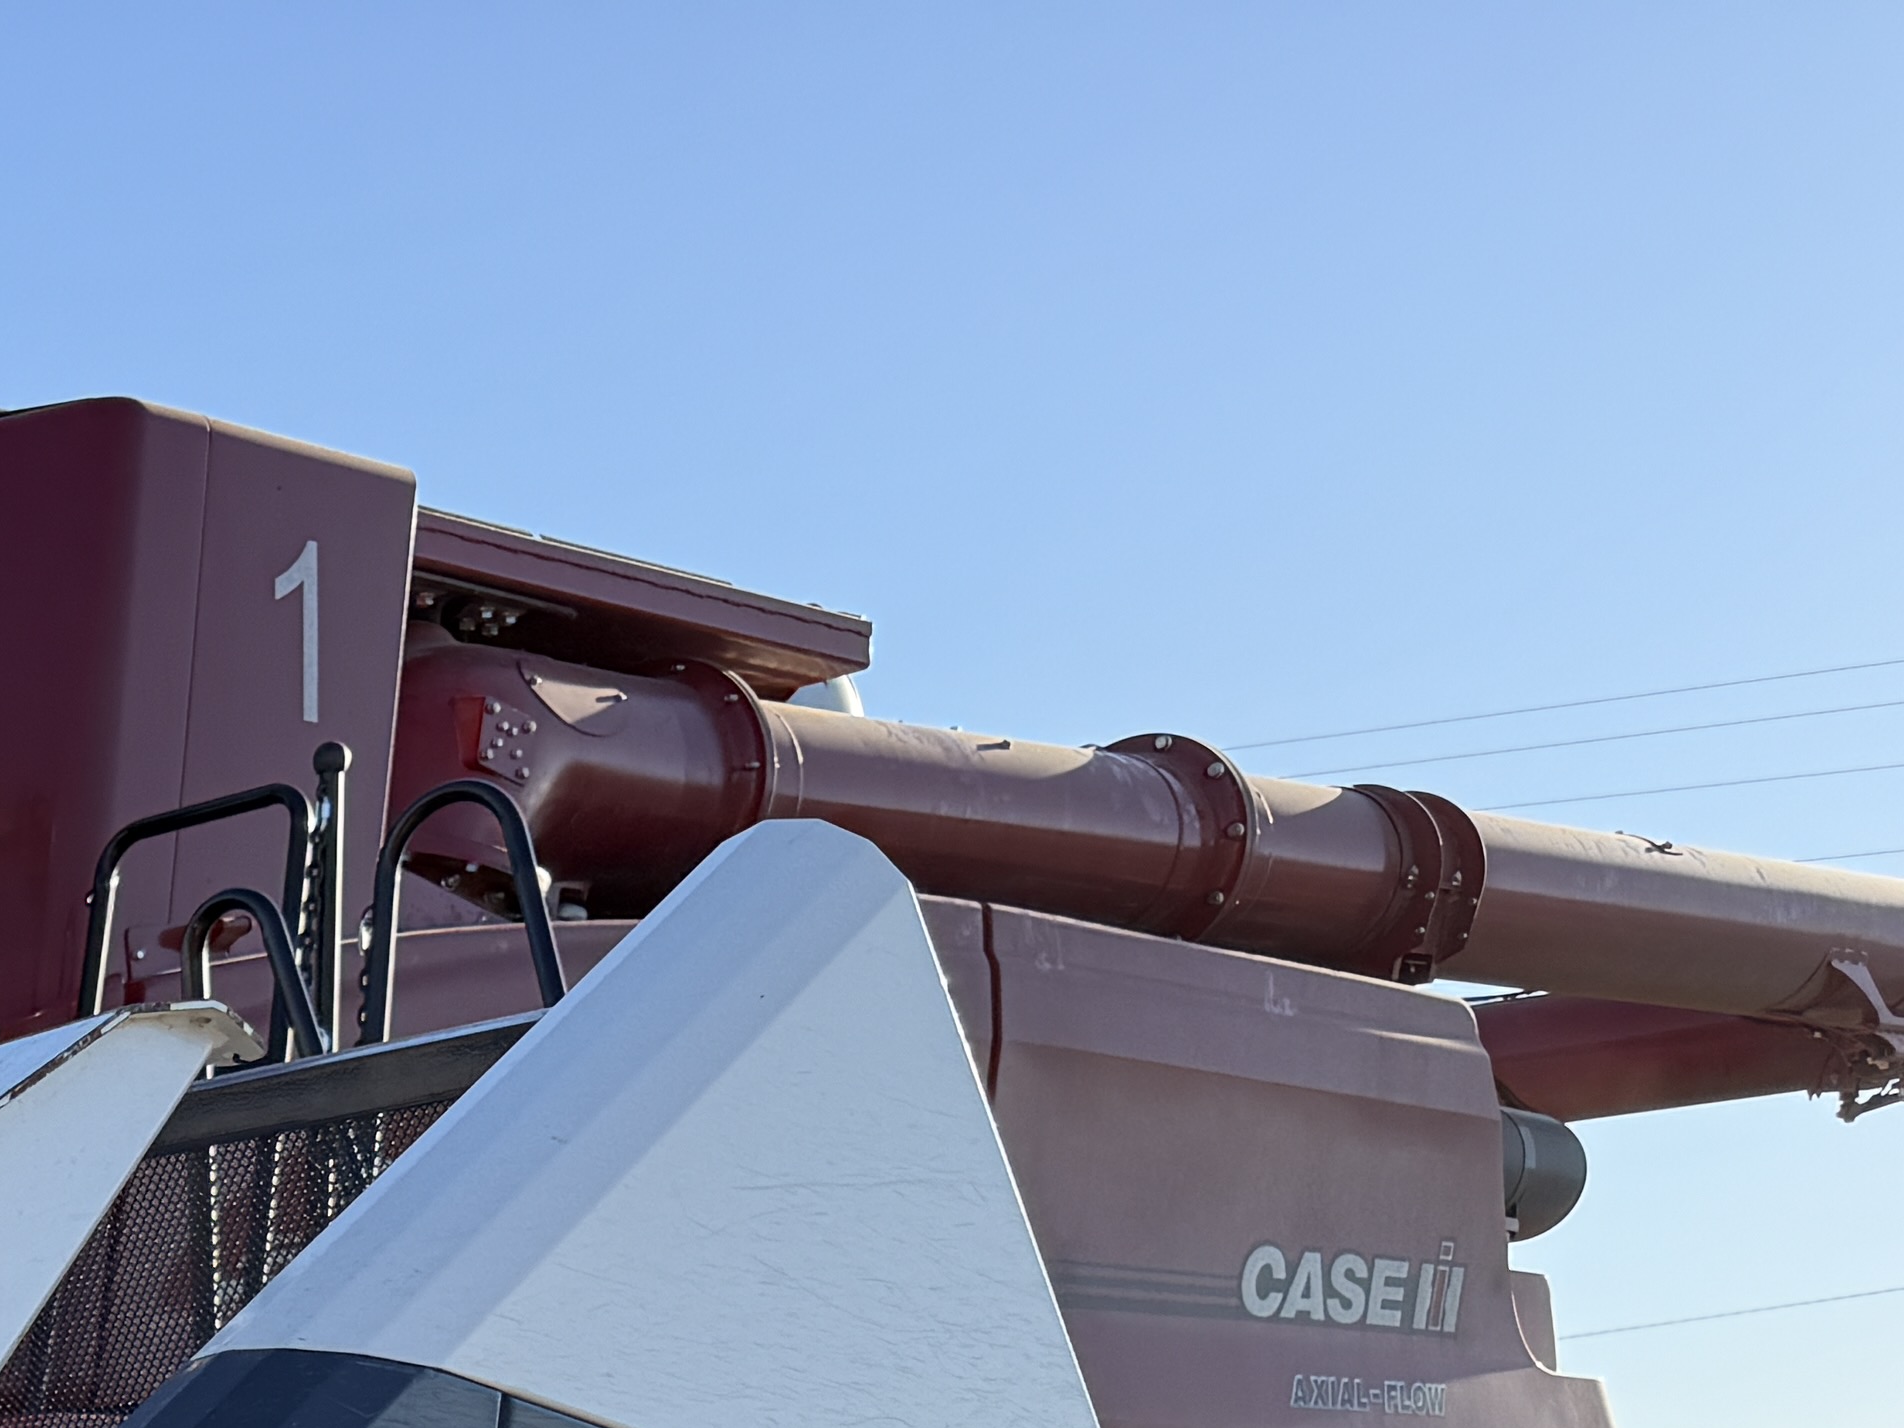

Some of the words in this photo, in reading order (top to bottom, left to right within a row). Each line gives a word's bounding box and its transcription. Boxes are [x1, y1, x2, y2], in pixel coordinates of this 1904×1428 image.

[274, 540, 319, 723] 1
[1241, 1245, 1409, 1327] CASE
[1290, 1374, 1447, 1417] AXIAL-FLOW
